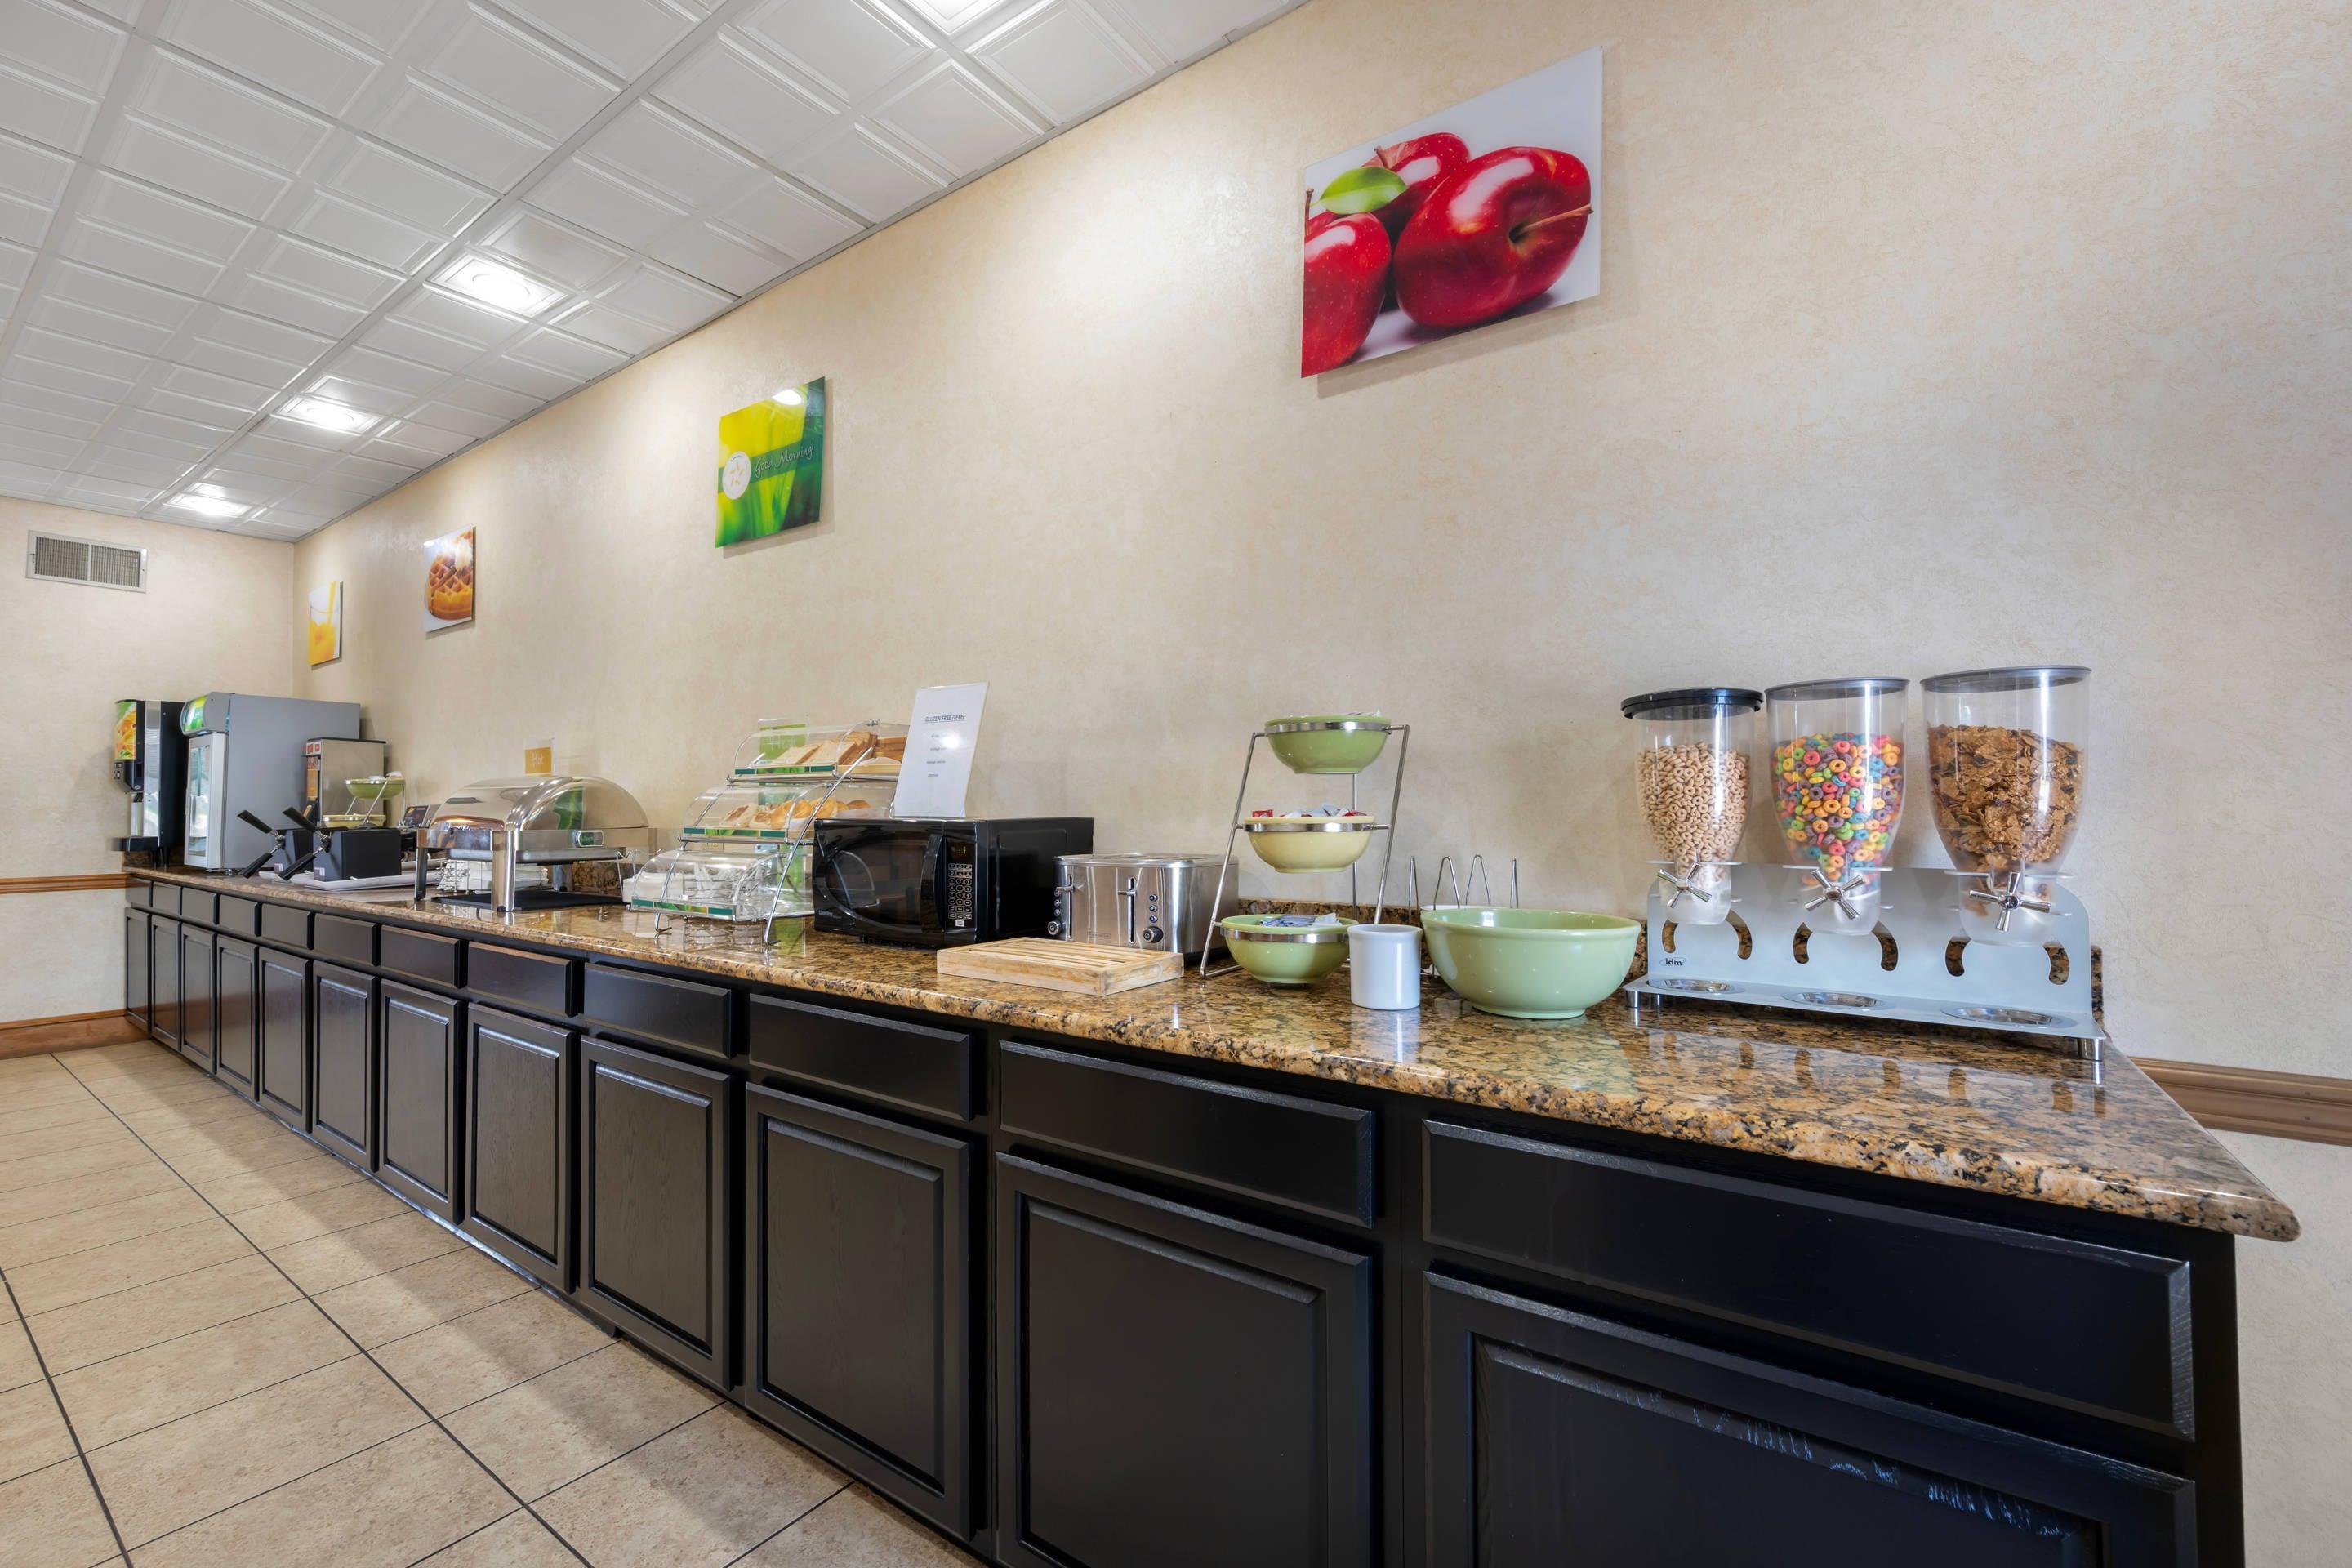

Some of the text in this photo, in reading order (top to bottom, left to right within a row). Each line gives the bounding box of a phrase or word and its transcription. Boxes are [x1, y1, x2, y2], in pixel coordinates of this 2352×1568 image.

[755, 441, 815, 478] Good Morning!
[1665, 958, 1682, 966] idm
